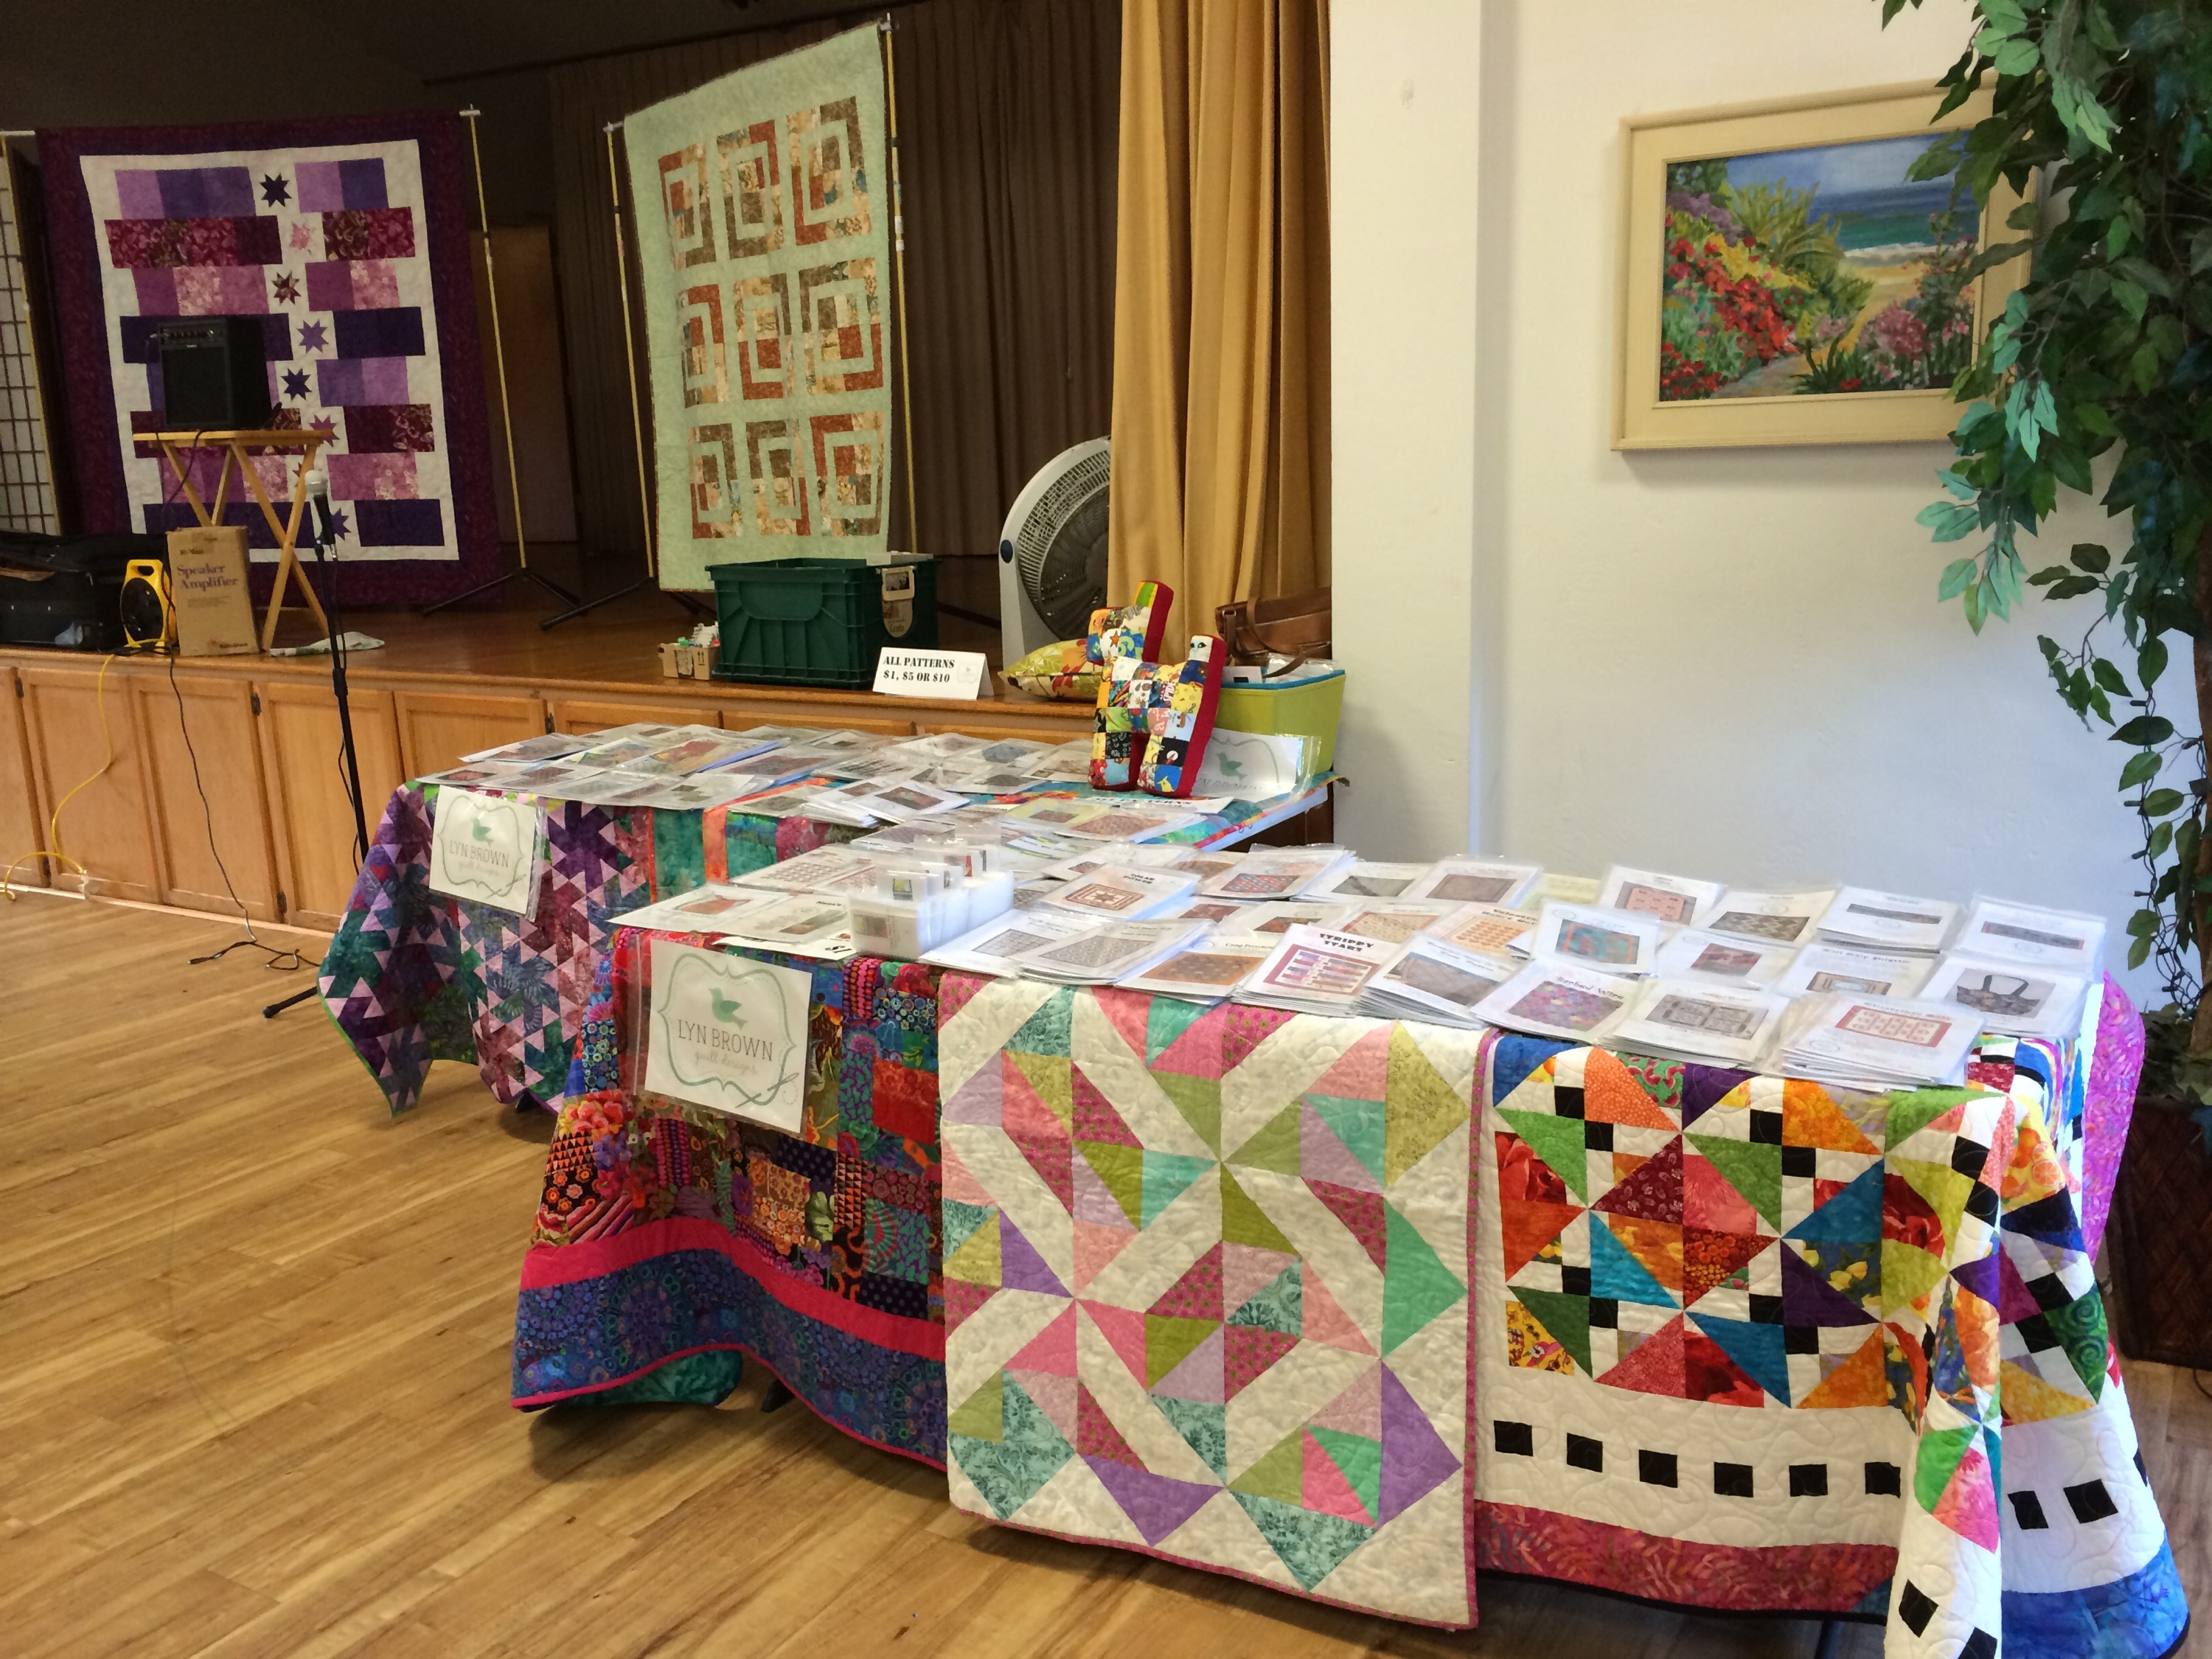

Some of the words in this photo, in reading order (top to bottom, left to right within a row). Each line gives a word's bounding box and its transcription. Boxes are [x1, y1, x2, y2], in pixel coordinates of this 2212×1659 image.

[176, 563, 226, 580] Speaker
[180, 576, 238, 592] Amplifier
[883, 656, 901, 666] ALL
[904, 657, 955, 669] PATTERNS
[883, 669, 899, 681] $1,
[902, 671, 914, 681] $5
[917, 672, 930, 682] OR
[933, 672, 950, 683] $10
[449, 840, 468, 858] LYN
[470, 845, 509, 868] BROWN
[1319, 933, 1374, 948] STRIPPY
[1324, 940, 1363, 952] START
[1598, 988, 1624, 1000] Wire
[678, 1019, 706, 1044] LYN
[712, 1028, 773, 1062] BROWN
[695, 1050, 718, 1066] quilt
[720, 1053, 758, 1075] designs
